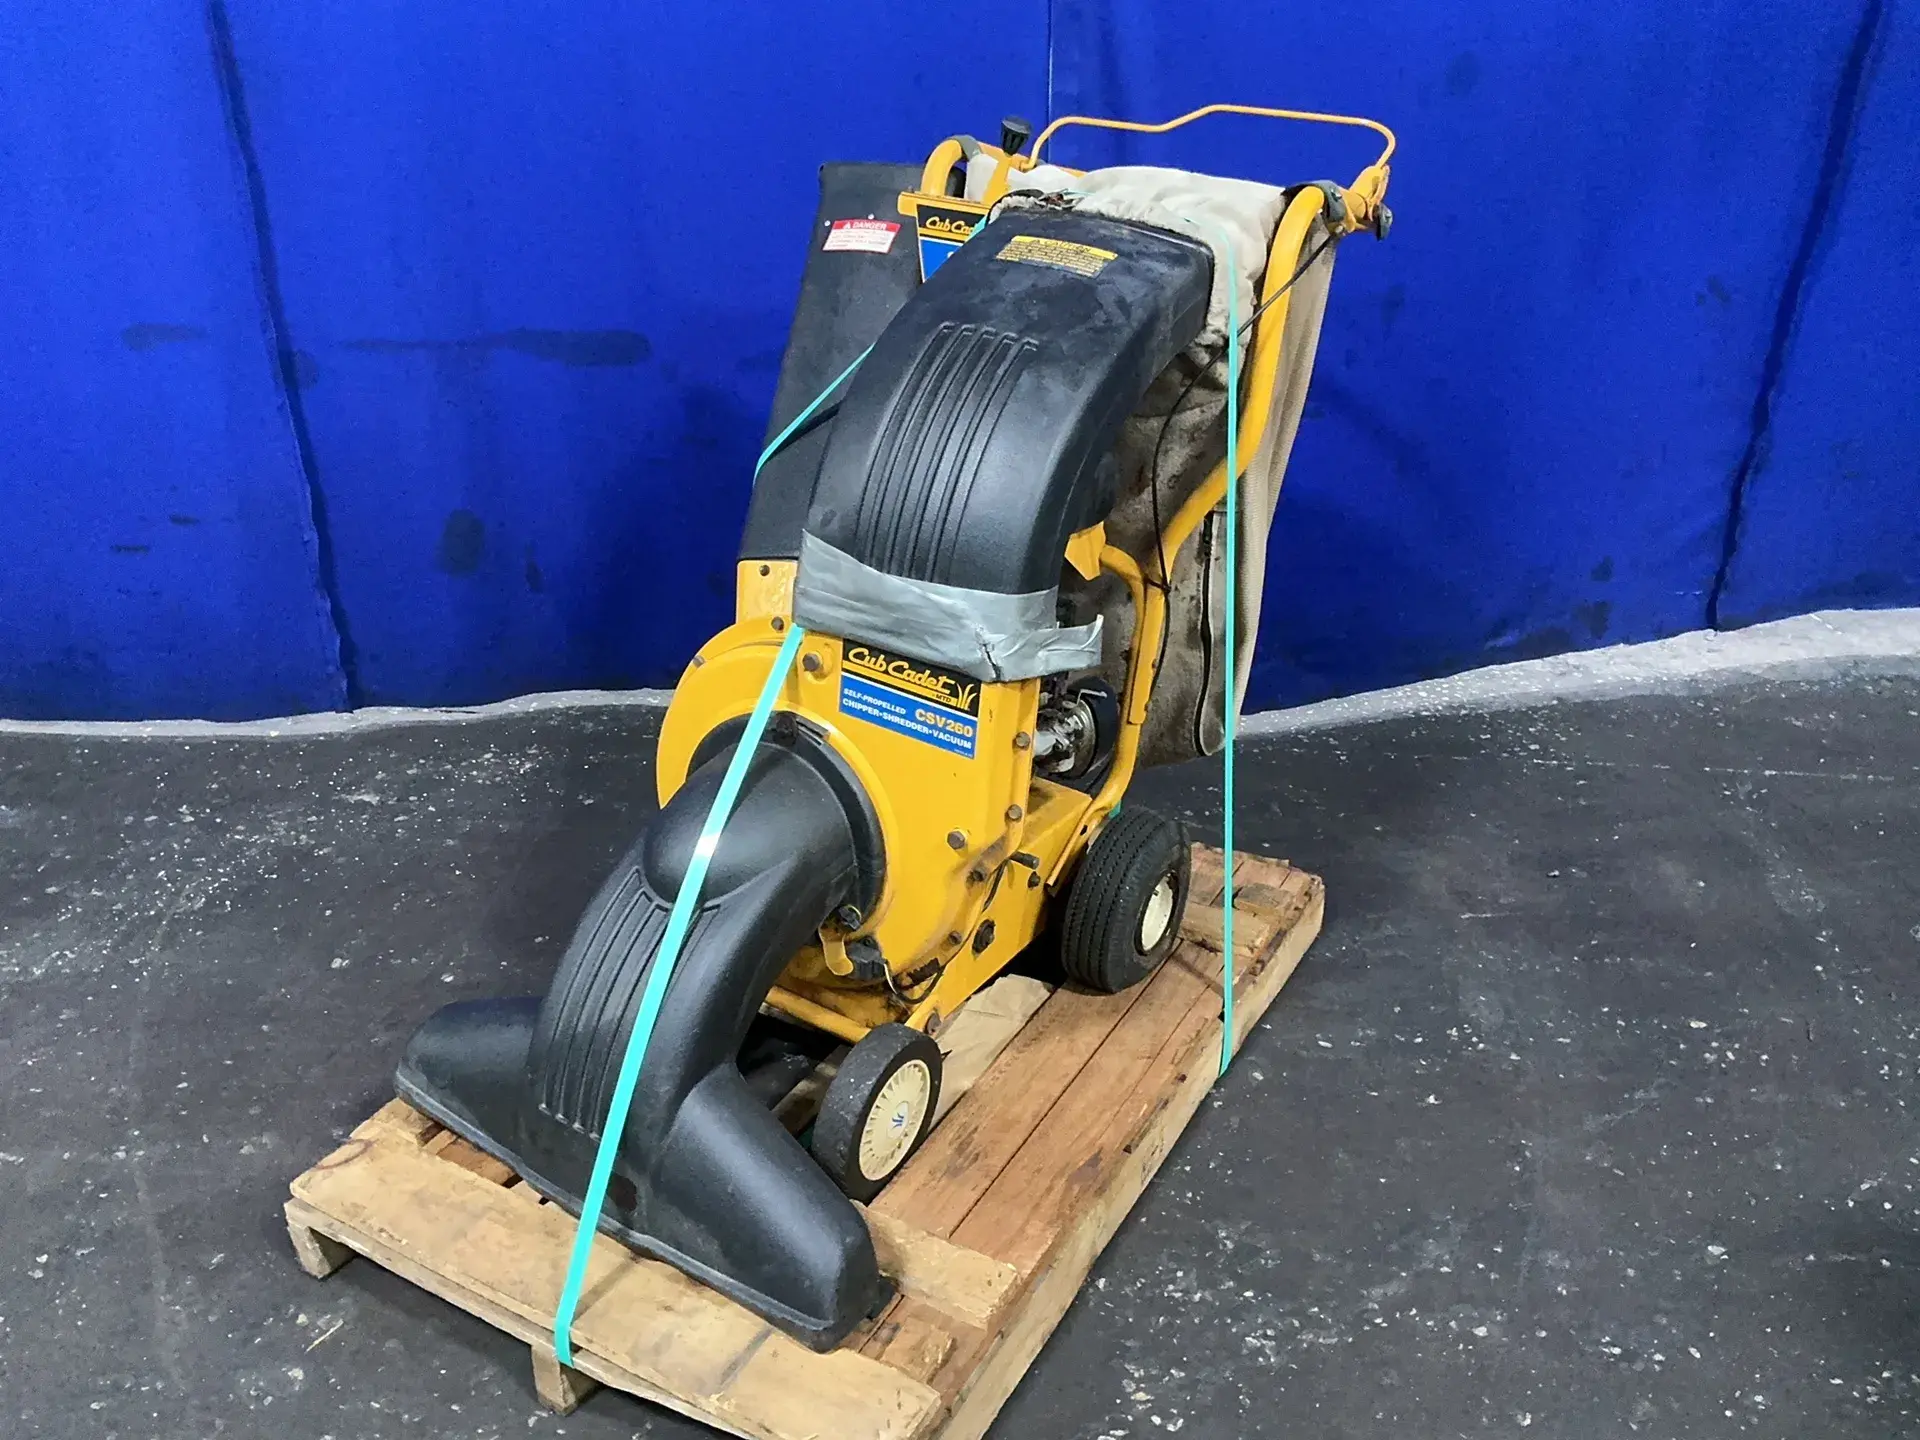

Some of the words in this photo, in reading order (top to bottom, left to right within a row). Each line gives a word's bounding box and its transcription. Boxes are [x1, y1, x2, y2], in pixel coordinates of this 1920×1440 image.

[852, 221, 887, 230] DANGER
[926, 216, 951, 232] Cub
[848, 647, 887, 672] Cub
[843, 687, 907, 715] SELF-PROPELLED
[915, 708, 973, 738] CSV260
